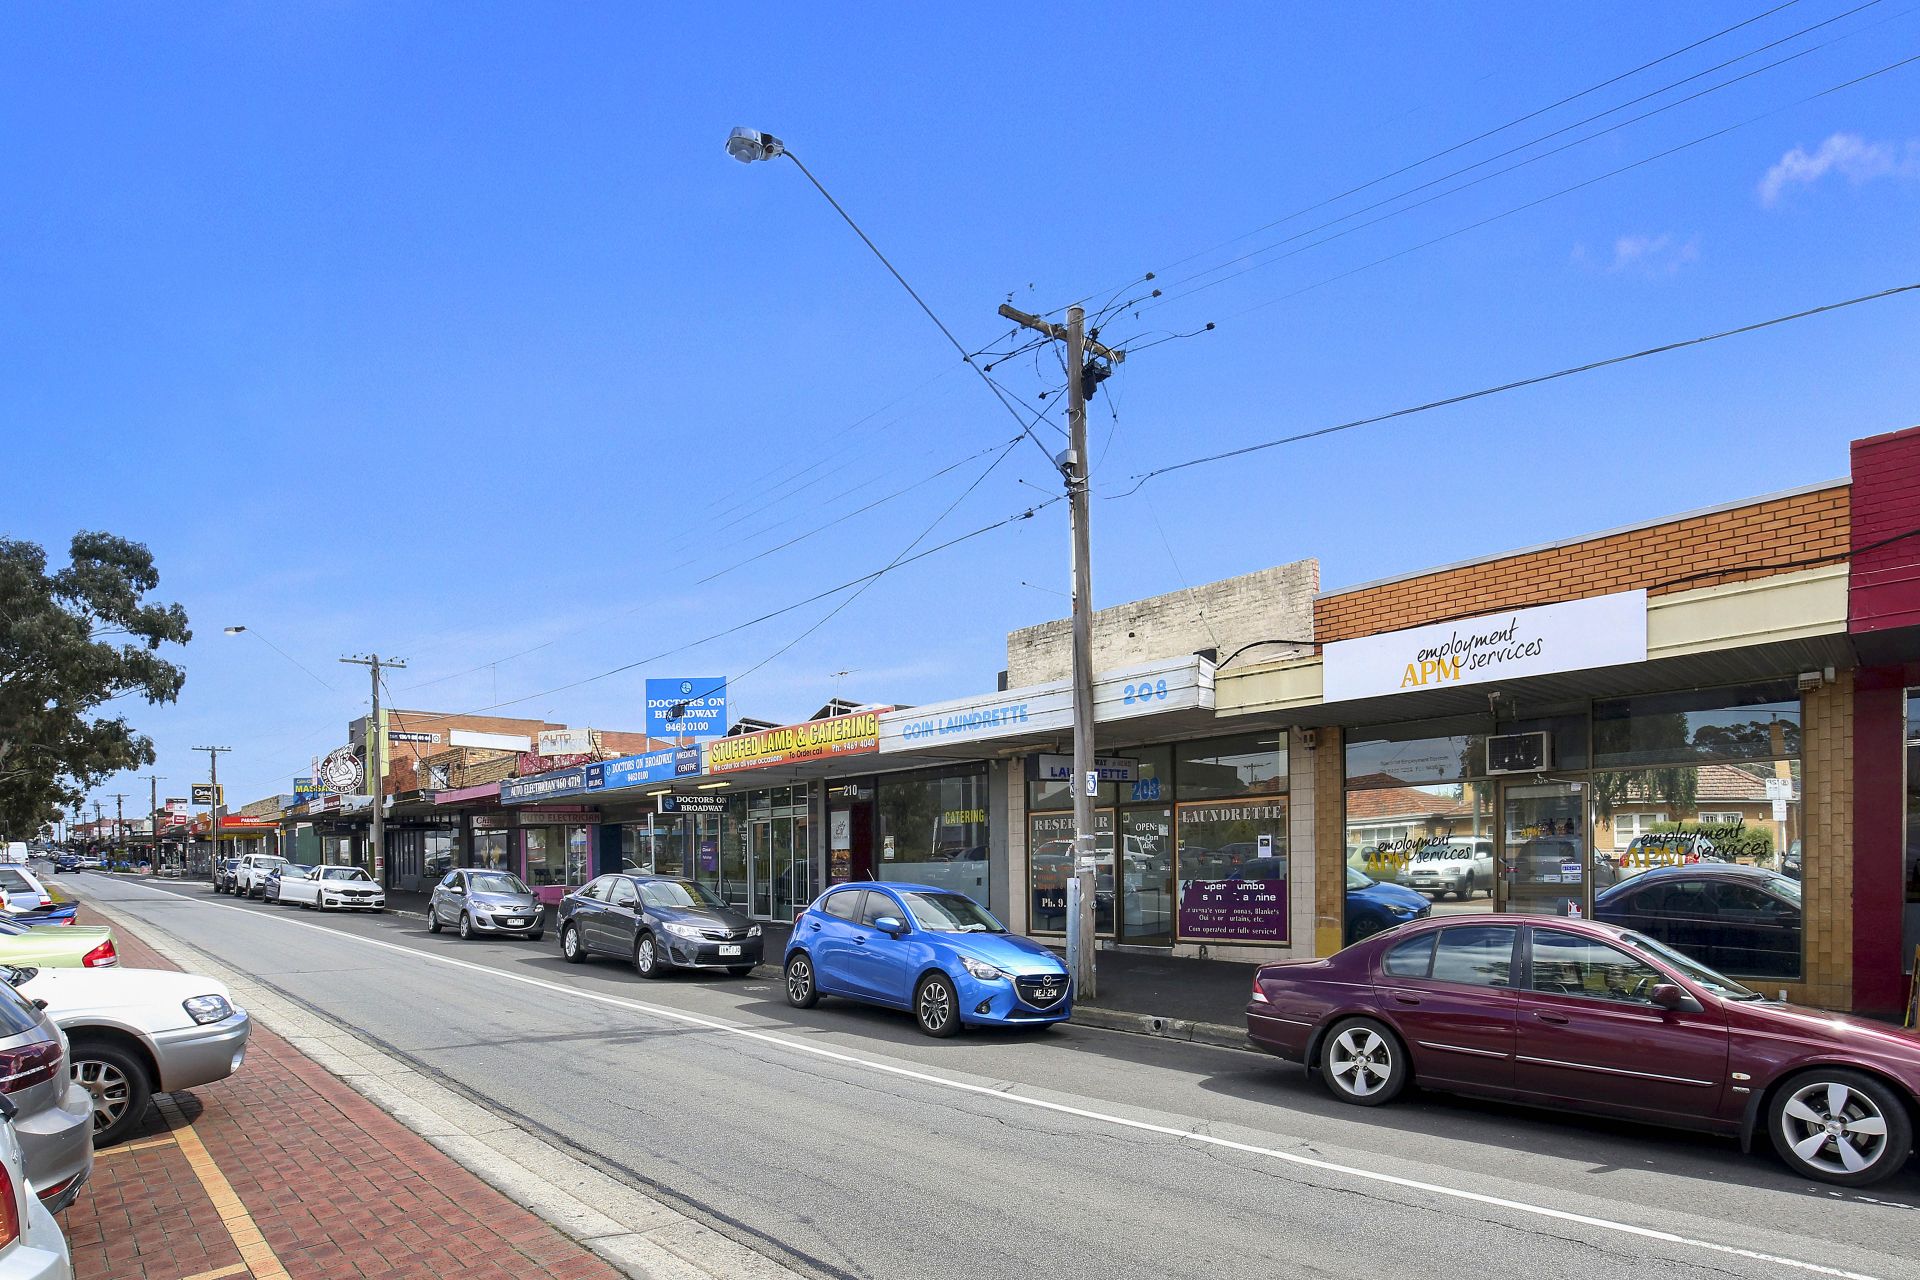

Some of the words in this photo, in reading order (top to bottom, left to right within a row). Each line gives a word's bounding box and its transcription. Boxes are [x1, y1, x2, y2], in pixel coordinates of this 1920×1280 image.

[1417, 617, 1519, 667] employment
[1400, 656, 1461, 688] APM
[1469, 638, 1543, 670] services
[1123, 679, 1168, 705] 208
[648, 698, 704, 708] DOCTORS
[707, 698, 725, 706] ON
[655, 710, 719, 719] BRDWAY
[687, 722, 709, 731] 0100
[903, 719, 934, 741] COIN
[938, 704, 1029, 735] LAUNDRETTE
[712, 736, 758, 762] STUFFED
[761, 729, 793, 754] LAMB
[797, 726, 807, 747] &
[809, 713, 877, 745] CATERING
[860, 738, 875, 749] 4040
[676, 749, 698, 760] MEDICAL
[758, 755, 783, 764] occasions
[789, 751, 795, 759] To
[796, 750, 811, 758] Order
[611, 760, 635, 774] DOCTORS
[636, 758, 644, 769] ON
[645, 752, 674, 768] BROADWAY
[677, 762, 697, 773] CENTRE
[1051, 766, 1128, 779] LAURETTE
[511, 786, 523, 797] AUTO
[524, 780, 555, 794] ELECTRICIAN
[567, 775, 581, 788] 4719
[844, 784, 857, 797] 210
[681, 804, 724, 812] BROADWAY
[1182, 805, 1281, 823] LAUNDRETTE
[547, 813, 600, 822] ELECTRICIAN
[945, 808, 984, 825] CATERING
[1135, 822, 1158, 831] OPEN:
[1641, 818, 1746, 855] employment
[1378, 828, 1453, 860] employment
[1366, 851, 1410, 872] APM
[1417, 846, 1471, 863] services
[1621, 846, 1685, 868] APM
[1693, 839, 1770, 860] services
[1204, 883, 1227, 891] uper
[1237, 882, 1265, 890] umbo
[1041, 898, 1056, 908] Ph.
